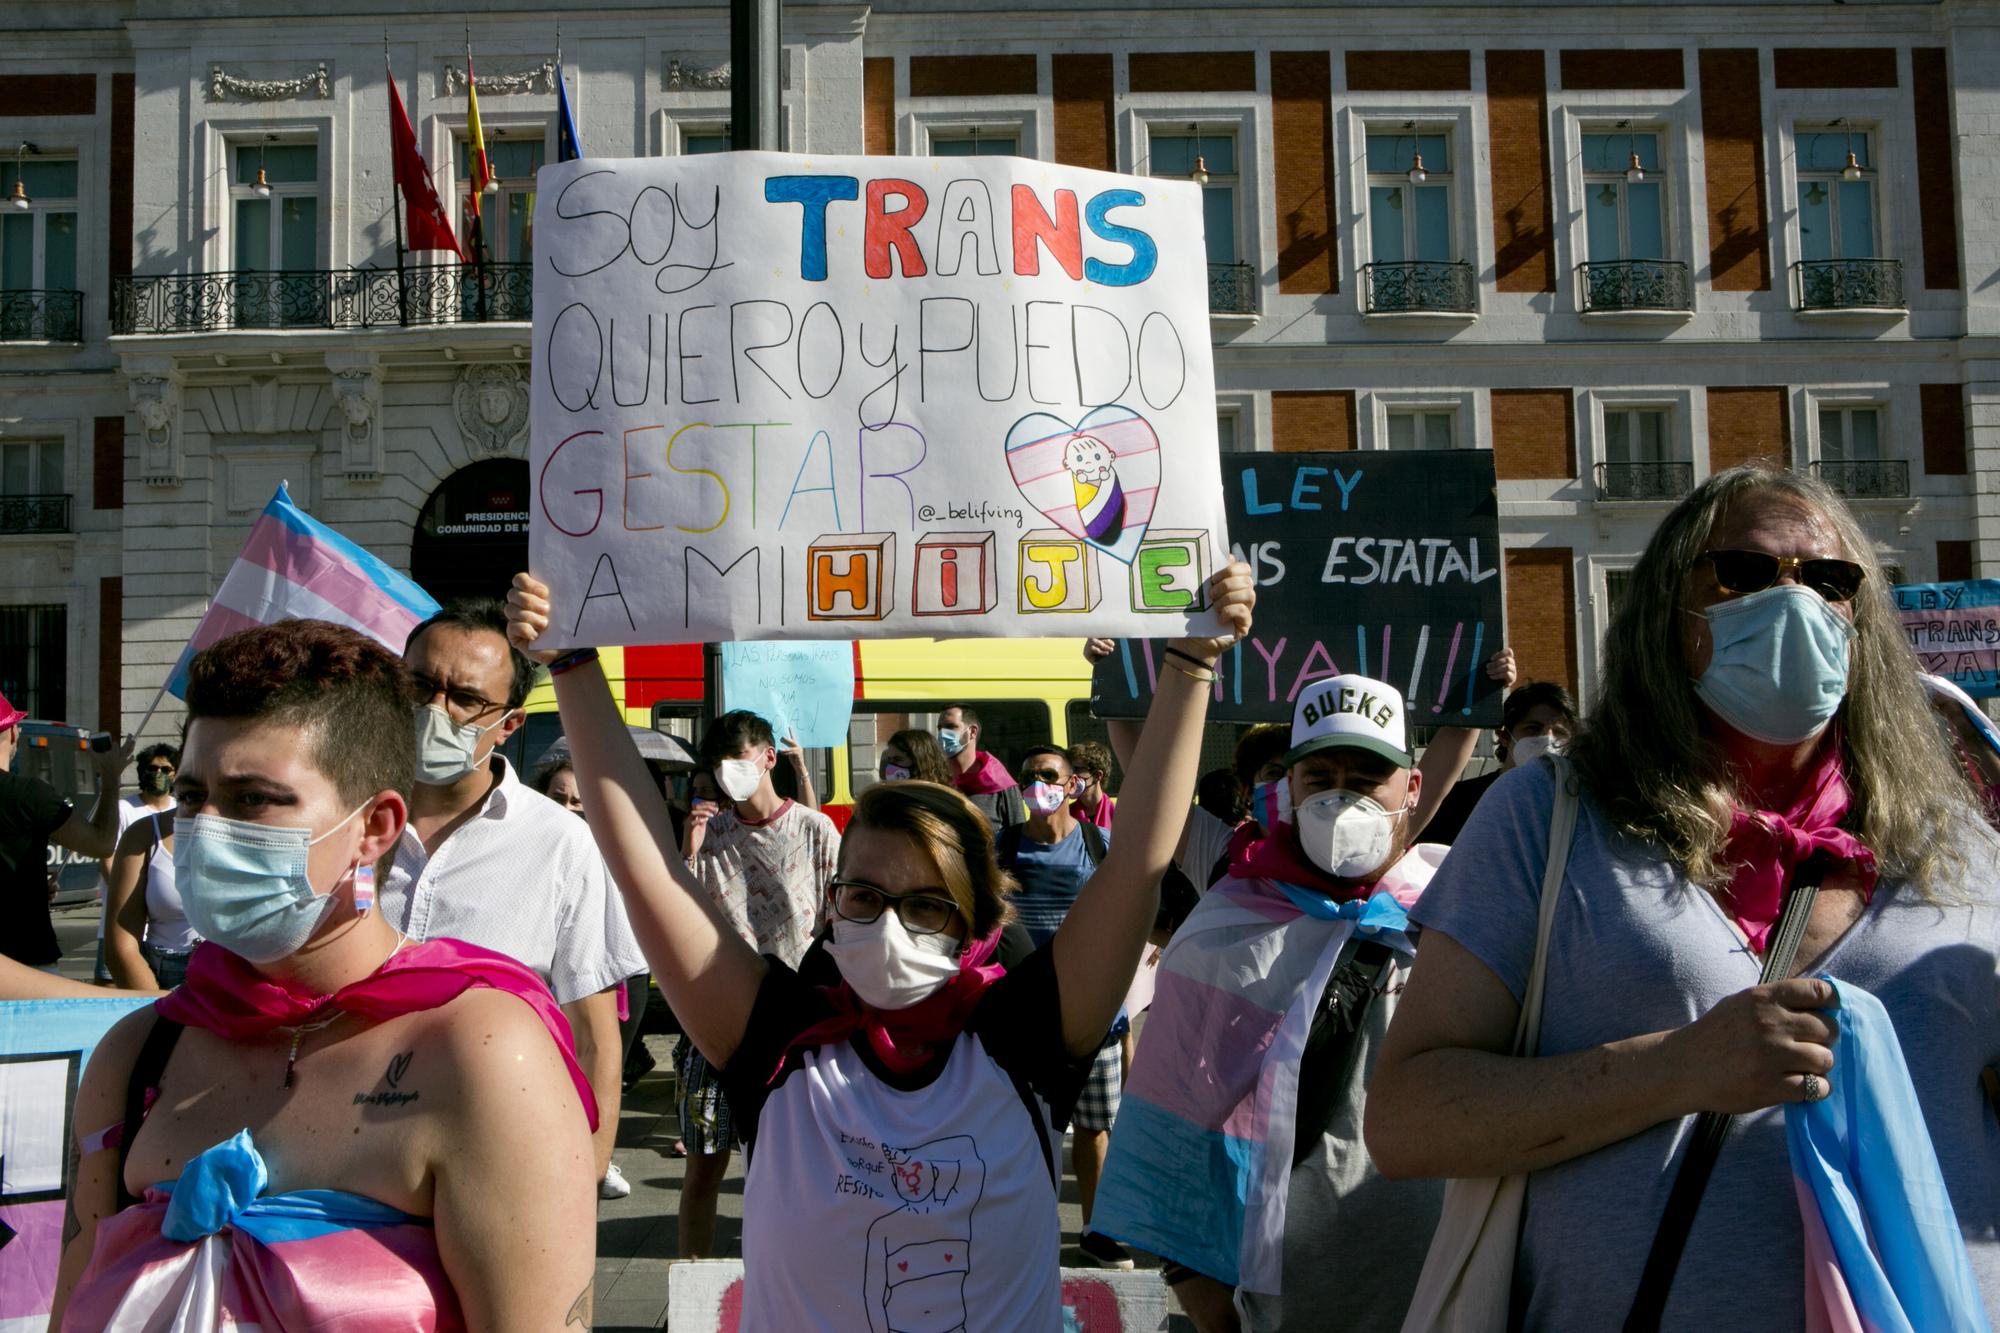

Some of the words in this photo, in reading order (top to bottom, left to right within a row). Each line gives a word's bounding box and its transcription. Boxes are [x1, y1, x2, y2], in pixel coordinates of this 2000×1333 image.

[764, 174, 1159, 288] TRANS
[539, 420, 928, 537] GESTAR
[1241, 466, 1363, 516] LEY
[436, 524, 501, 534] COMUNIDAD
[504, 523, 519, 532] DE
[1320, 536, 1498, 586] ESTATAL
[573, 553, 636, 637] A
[684, 545, 785, 628] MI
[1897, 587, 1965, 610] LEY
[1903, 619, 2000, 645] TRANS
[1302, 686, 1395, 729] BUCKS
